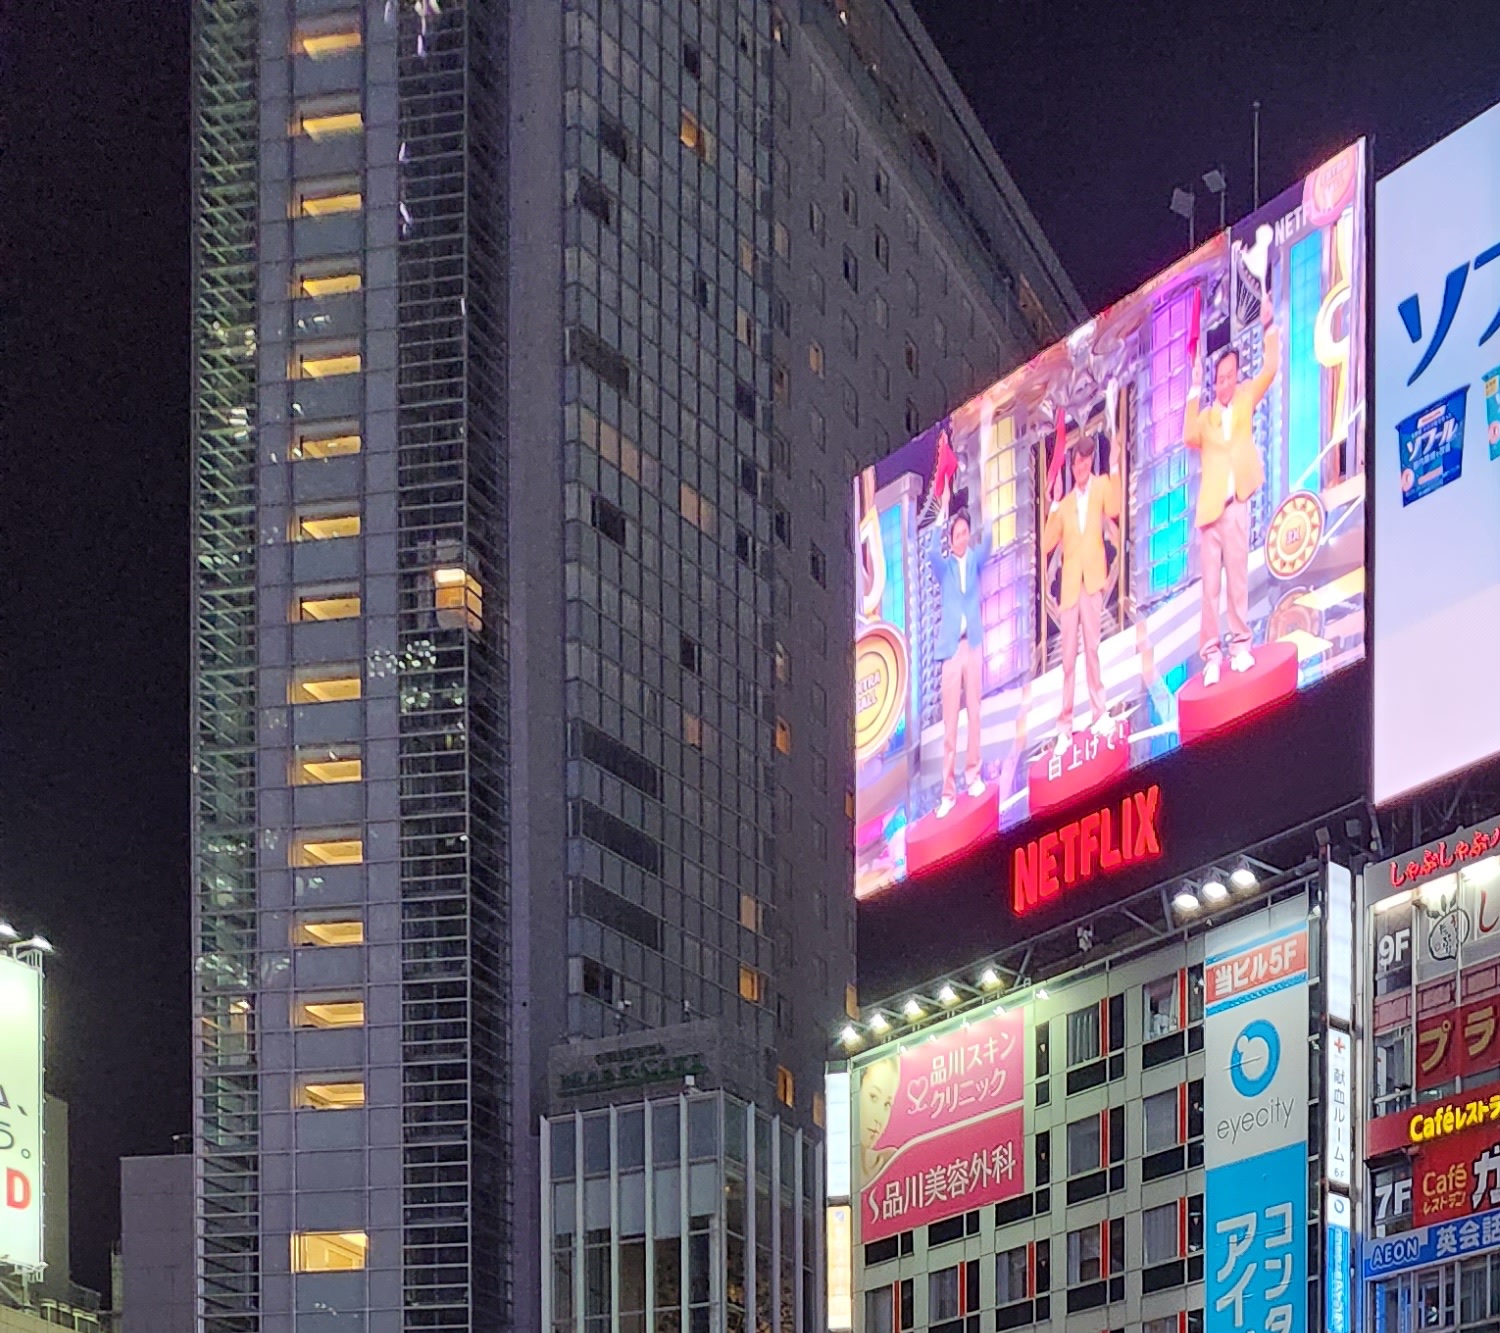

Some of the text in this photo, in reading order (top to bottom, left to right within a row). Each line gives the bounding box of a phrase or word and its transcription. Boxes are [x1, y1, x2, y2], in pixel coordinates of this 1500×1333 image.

[1407, 418, 1458, 462] ソフール
[1014, 784, 1161, 914] NETFLIX
[1215, 938, 1298, 998] 当ビル5F
[1378, 927, 1411, 966] 9F
[931, 1031, 1017, 1090] 品川スキン
[929, 1068, 1007, 1118] クリニック
[1332, 1066, 1347, 1163] 献血ルーム
[1216, 1098, 1295, 1144] eyecity
[882, 1146, 1017, 1222] 品川美容外科
[1375, 1181, 1412, 1221] 7F
[1421, 1164, 1468, 1197] Café
[1371, 1238, 1420, 1270] AEON
